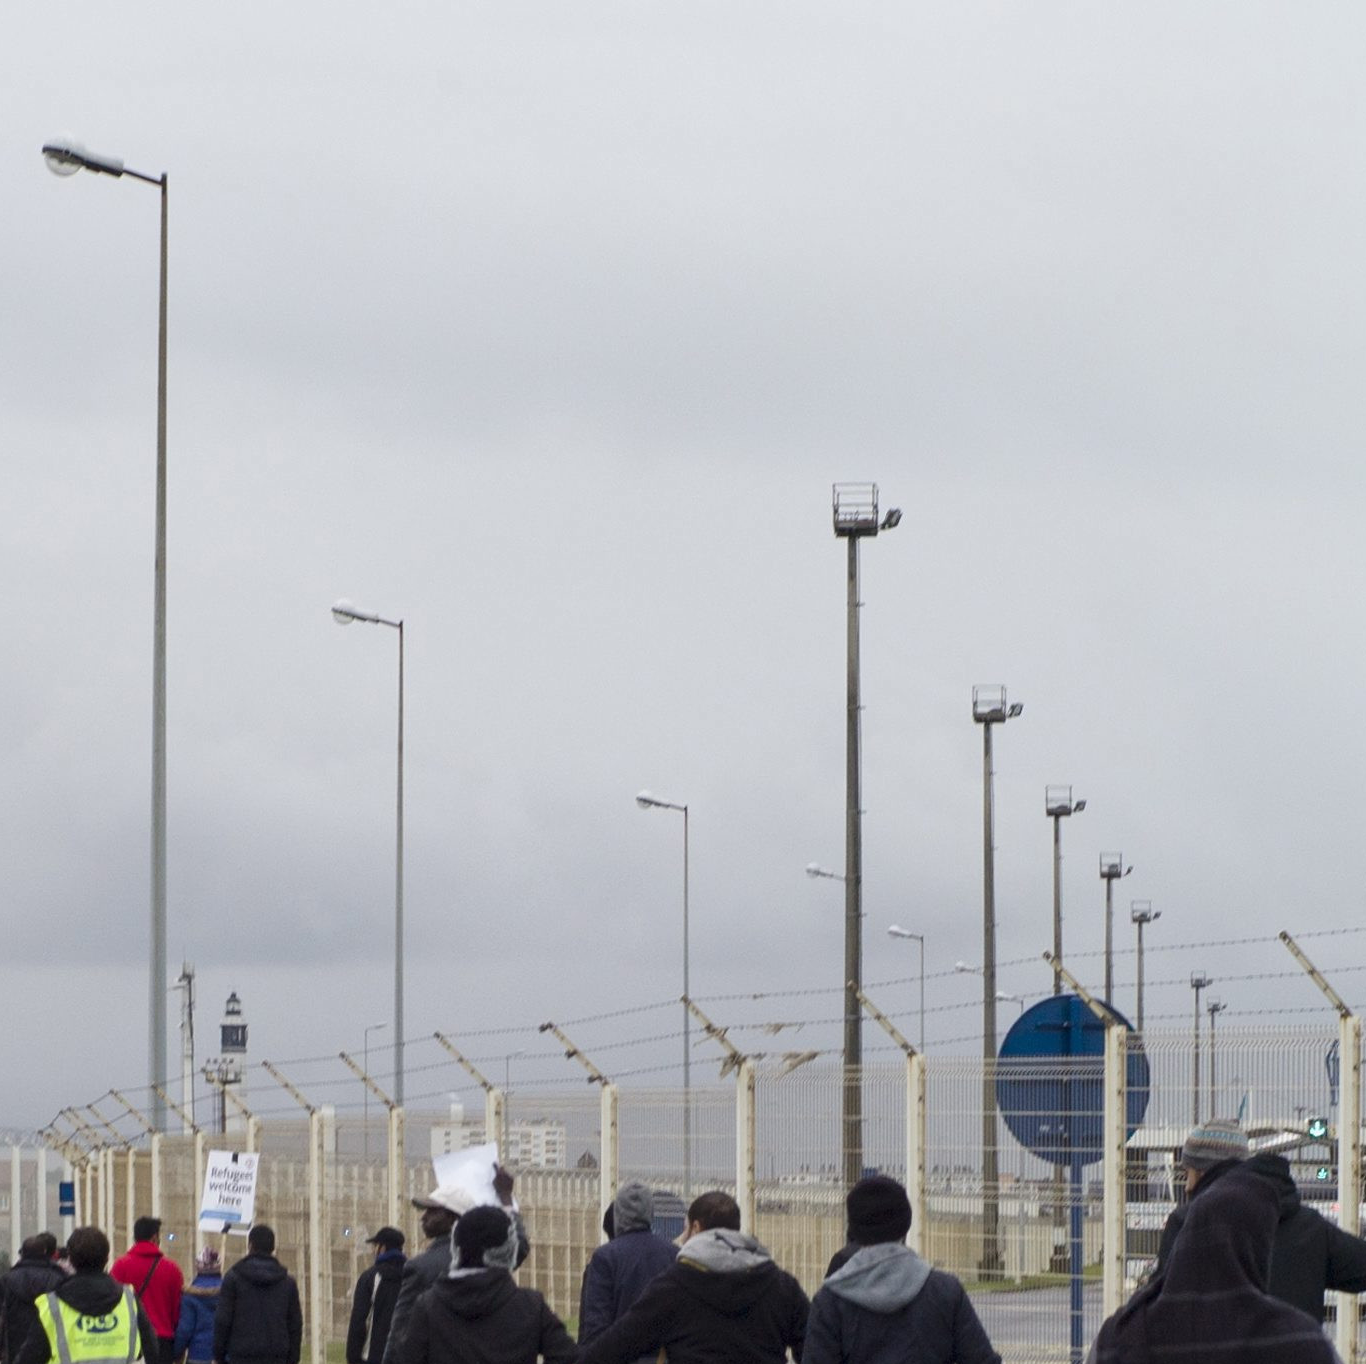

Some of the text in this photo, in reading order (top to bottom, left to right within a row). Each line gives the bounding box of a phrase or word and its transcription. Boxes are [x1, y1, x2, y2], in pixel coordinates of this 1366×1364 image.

[211, 1167, 253, 1182] Refugees
[209, 1181, 252, 1194] welcome
[218, 1192, 242, 1206] here
[81, 1314, 115, 1331] pcs
